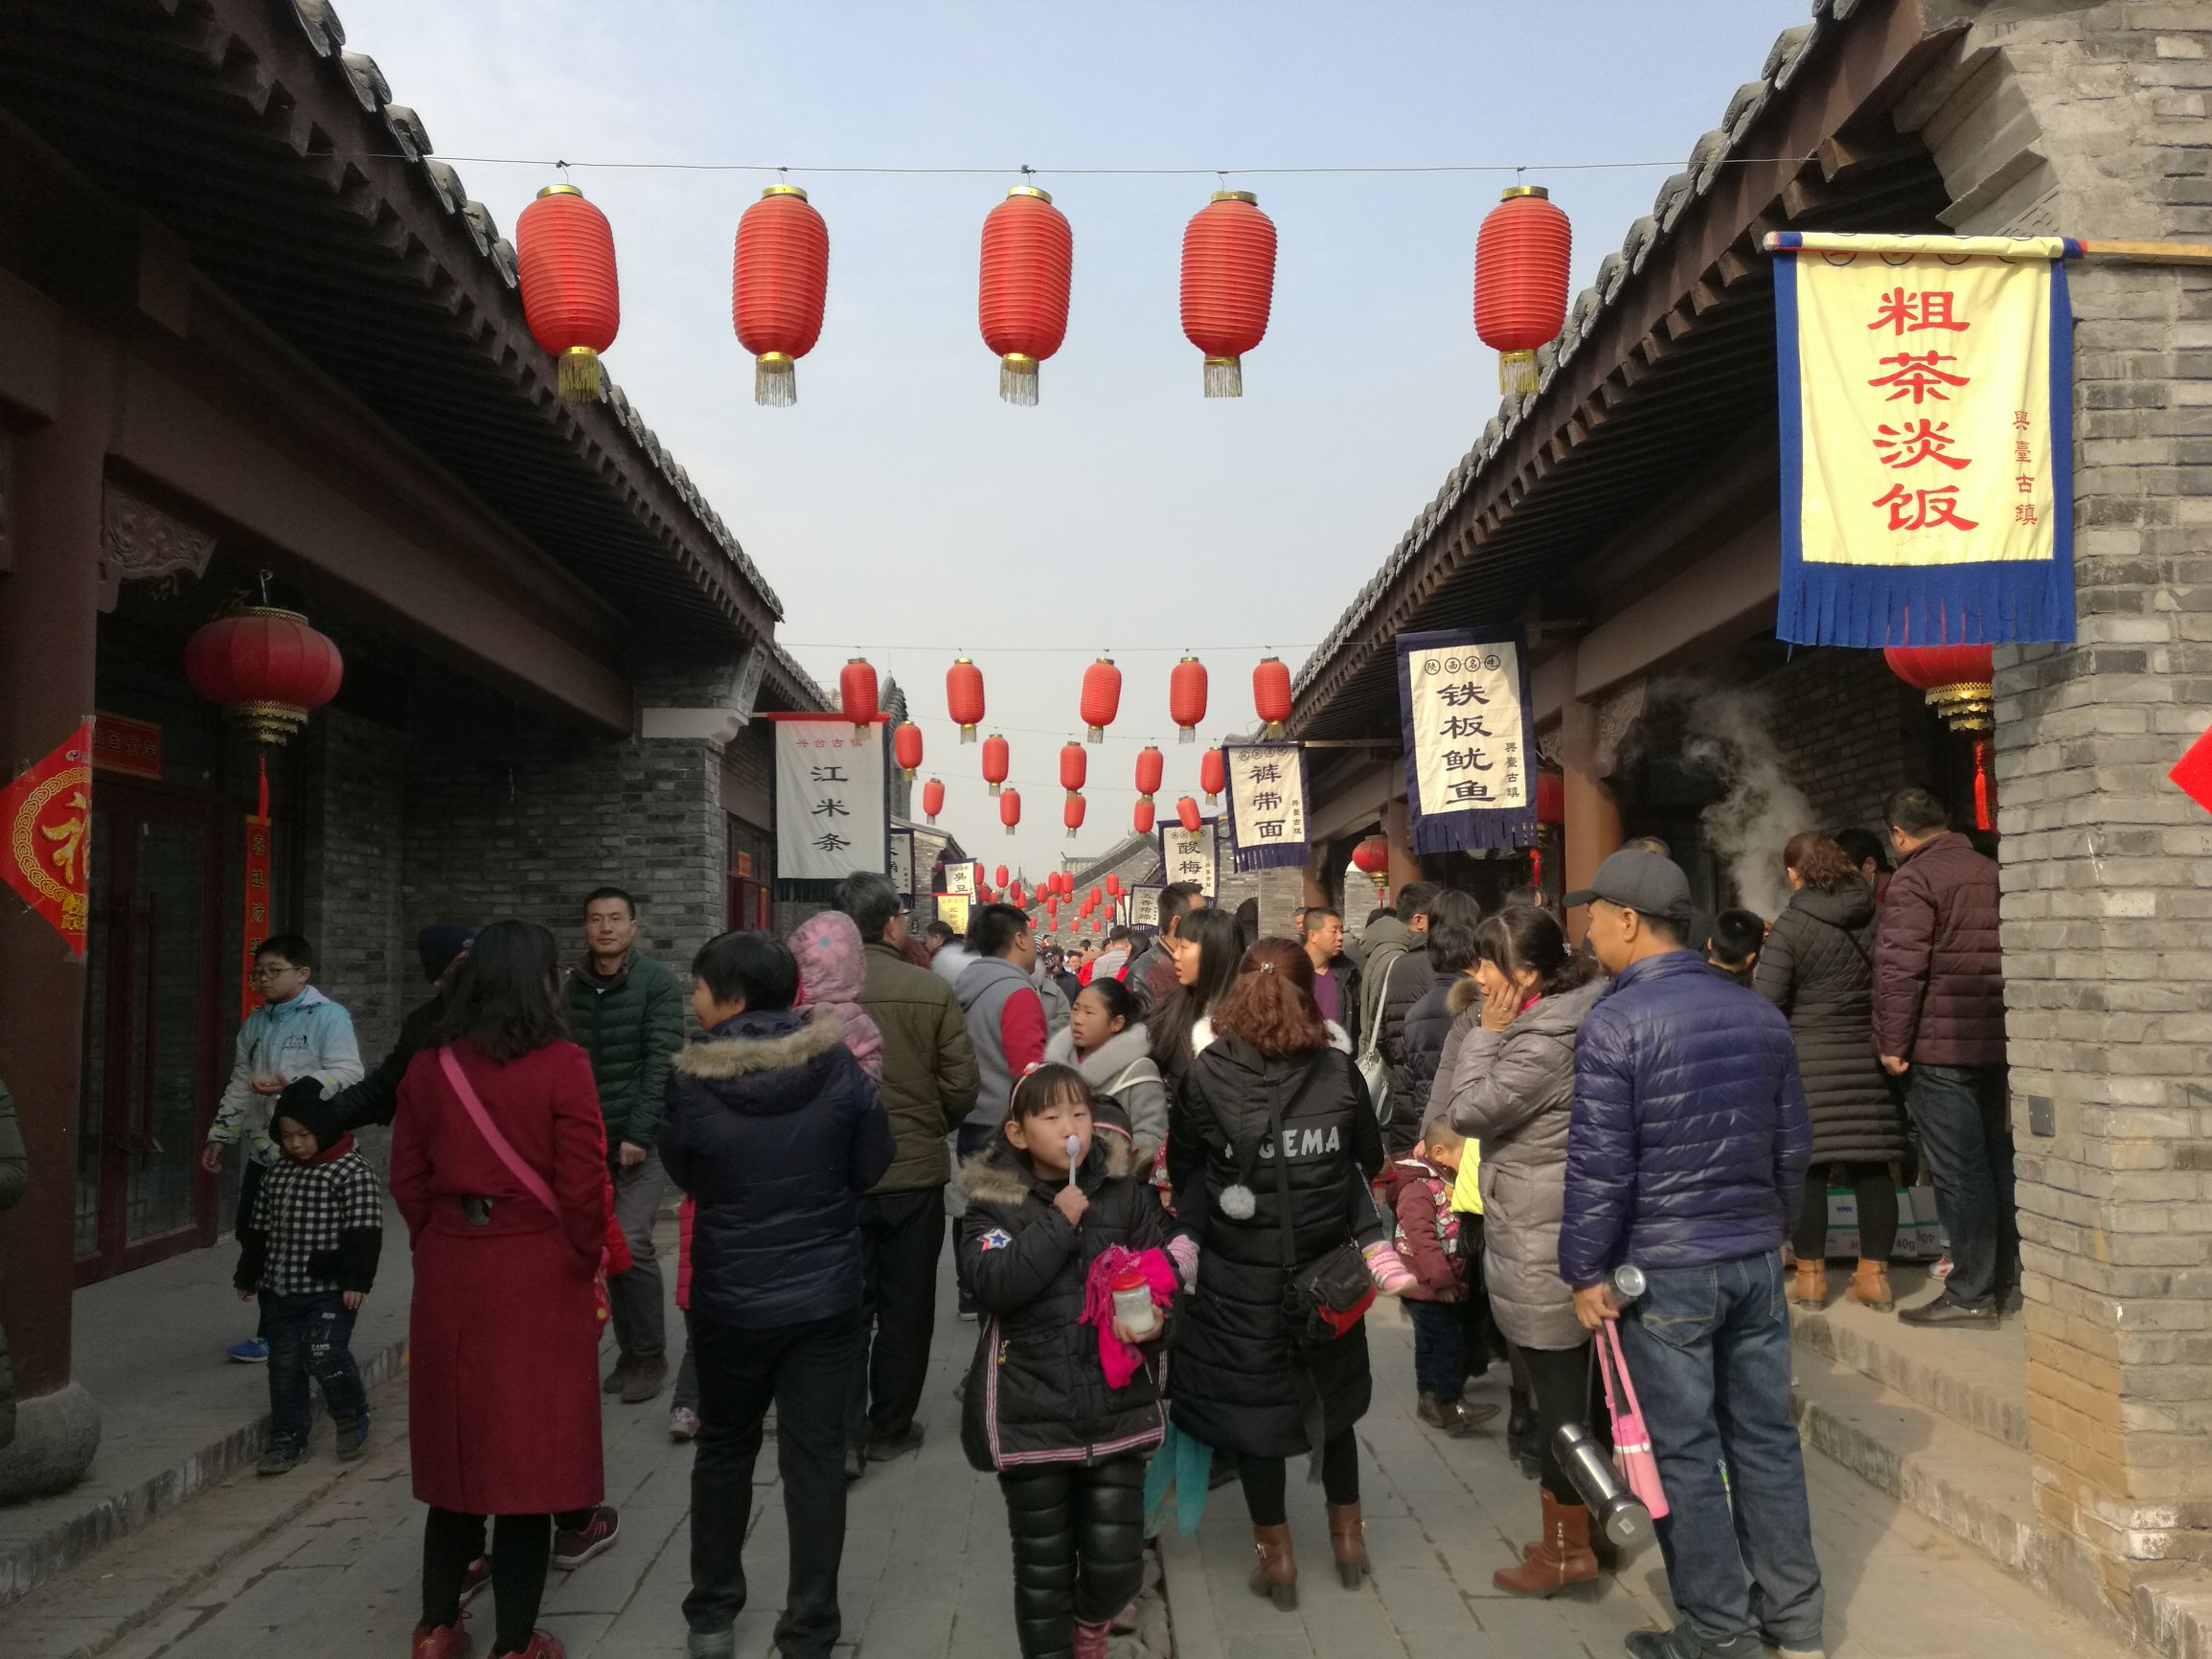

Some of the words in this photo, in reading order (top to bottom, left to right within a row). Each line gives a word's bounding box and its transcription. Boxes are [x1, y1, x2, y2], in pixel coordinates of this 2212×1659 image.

[1867, 286, 1979, 532] 粗茶淡饭
[1425, 655, 1500, 674] 陕西名吃
[1437, 681, 1496, 806] 铁板鱿鱼
[810, 765, 851, 852] 江米条
[1249, 763, 1286, 839] 裤带面
[1176, 841, 1203, 889] 酸梅
